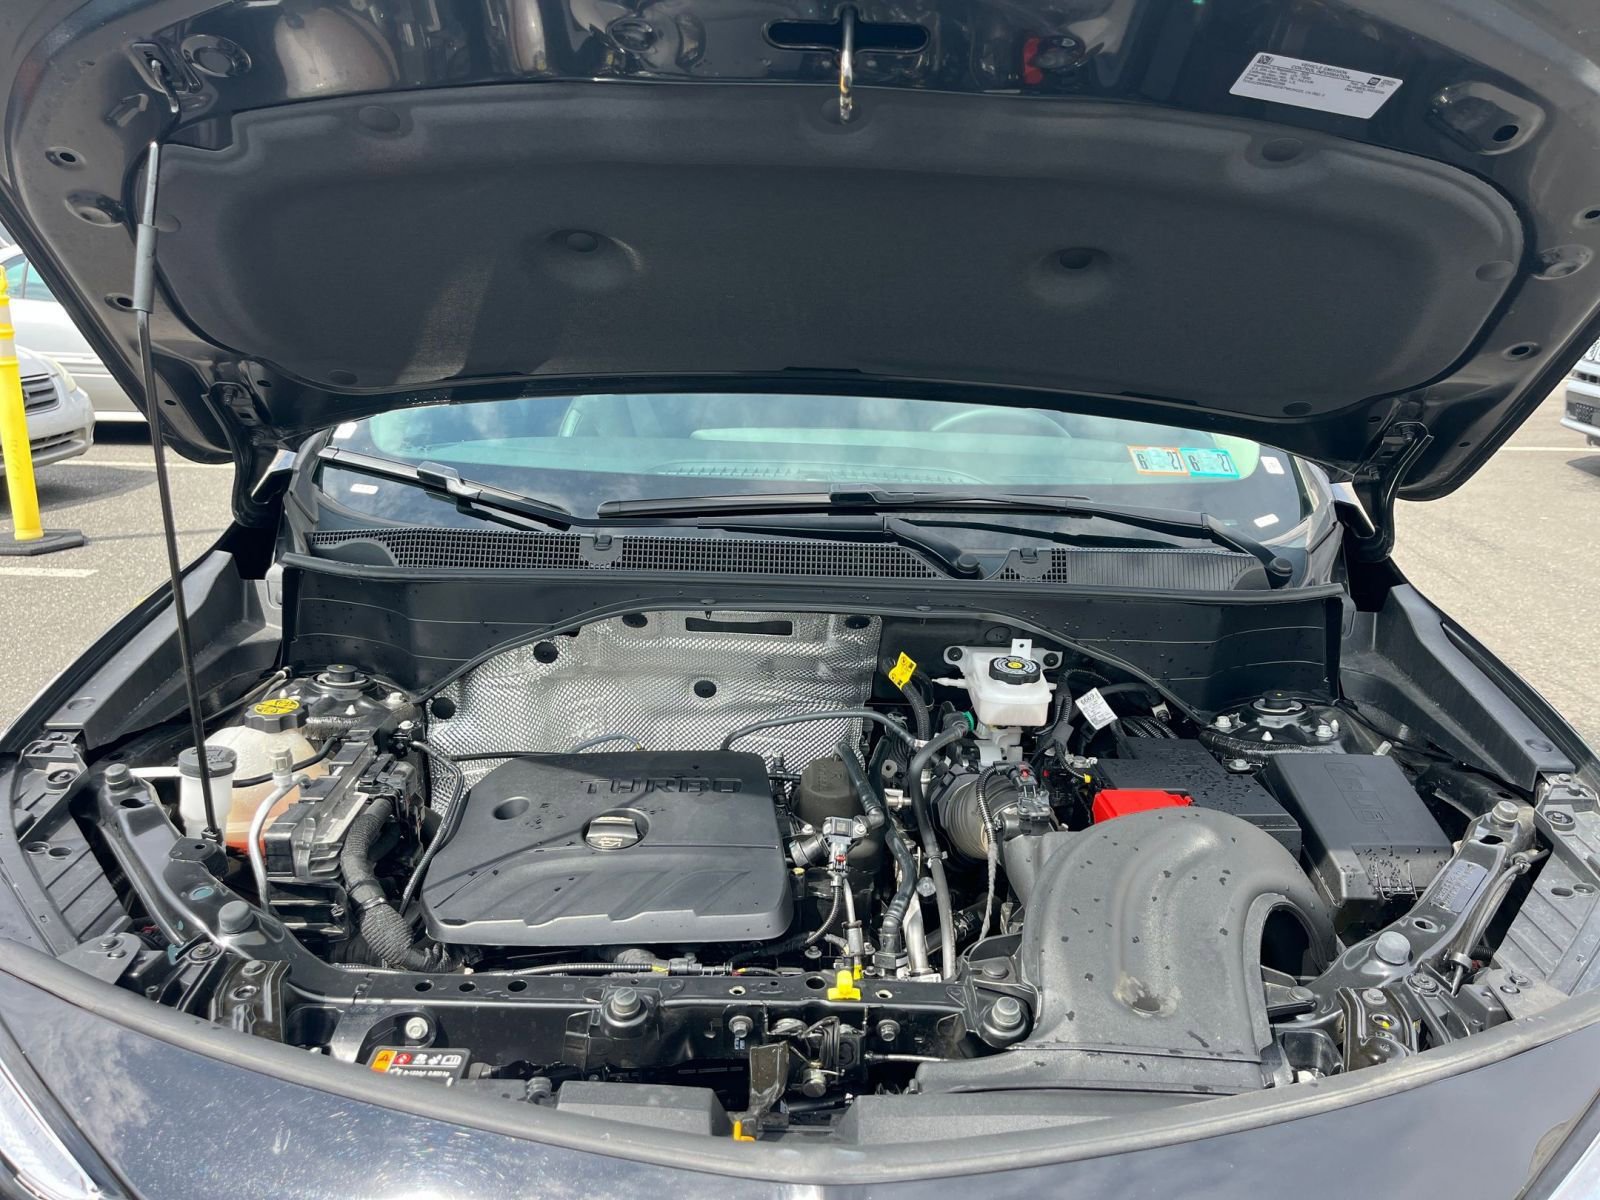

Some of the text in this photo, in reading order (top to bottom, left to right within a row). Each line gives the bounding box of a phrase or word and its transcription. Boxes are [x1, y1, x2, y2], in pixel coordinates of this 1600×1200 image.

[1137, 451, 1183, 471] 6 27
[1188, 453, 1233, 472] 6 27
[580, 777, 743, 794] TURBO
